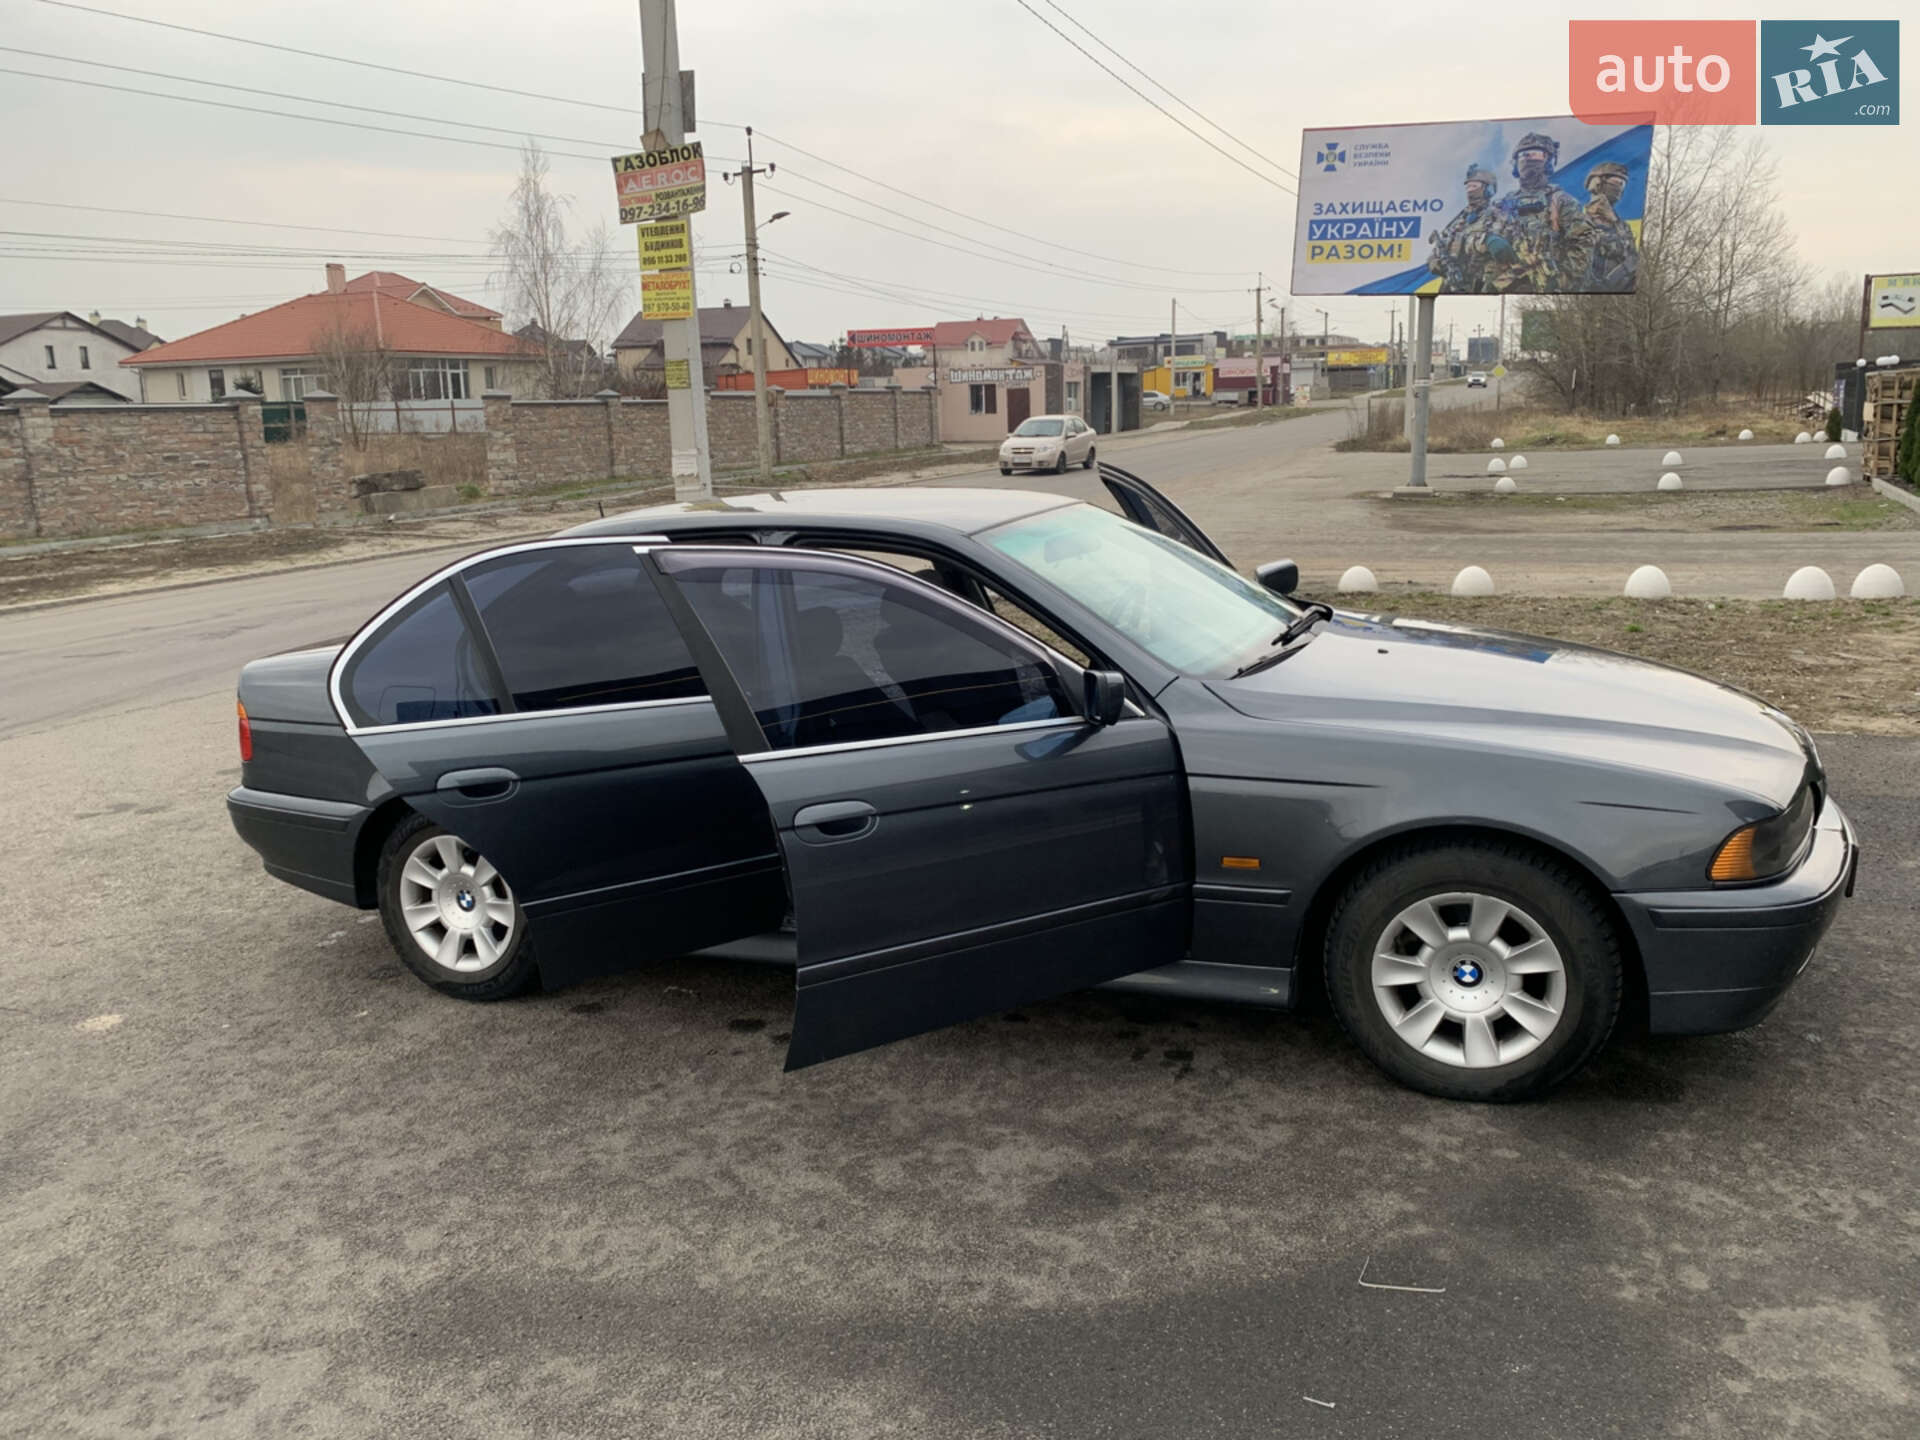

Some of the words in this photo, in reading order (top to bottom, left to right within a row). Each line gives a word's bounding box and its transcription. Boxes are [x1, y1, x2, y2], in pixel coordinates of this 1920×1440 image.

[612, 142, 702, 172] ГАЗОБЛОК
[623, 166, 700, 193] AEROC
[1313, 199, 1444, 215] ЗАХИЩАЄМО
[1311, 217, 1414, 240] УКРАЇНУ
[1311, 243, 1403, 260] РАЗОМ!
[856, 332, 933, 344] ШИНОМОНТАЖ
